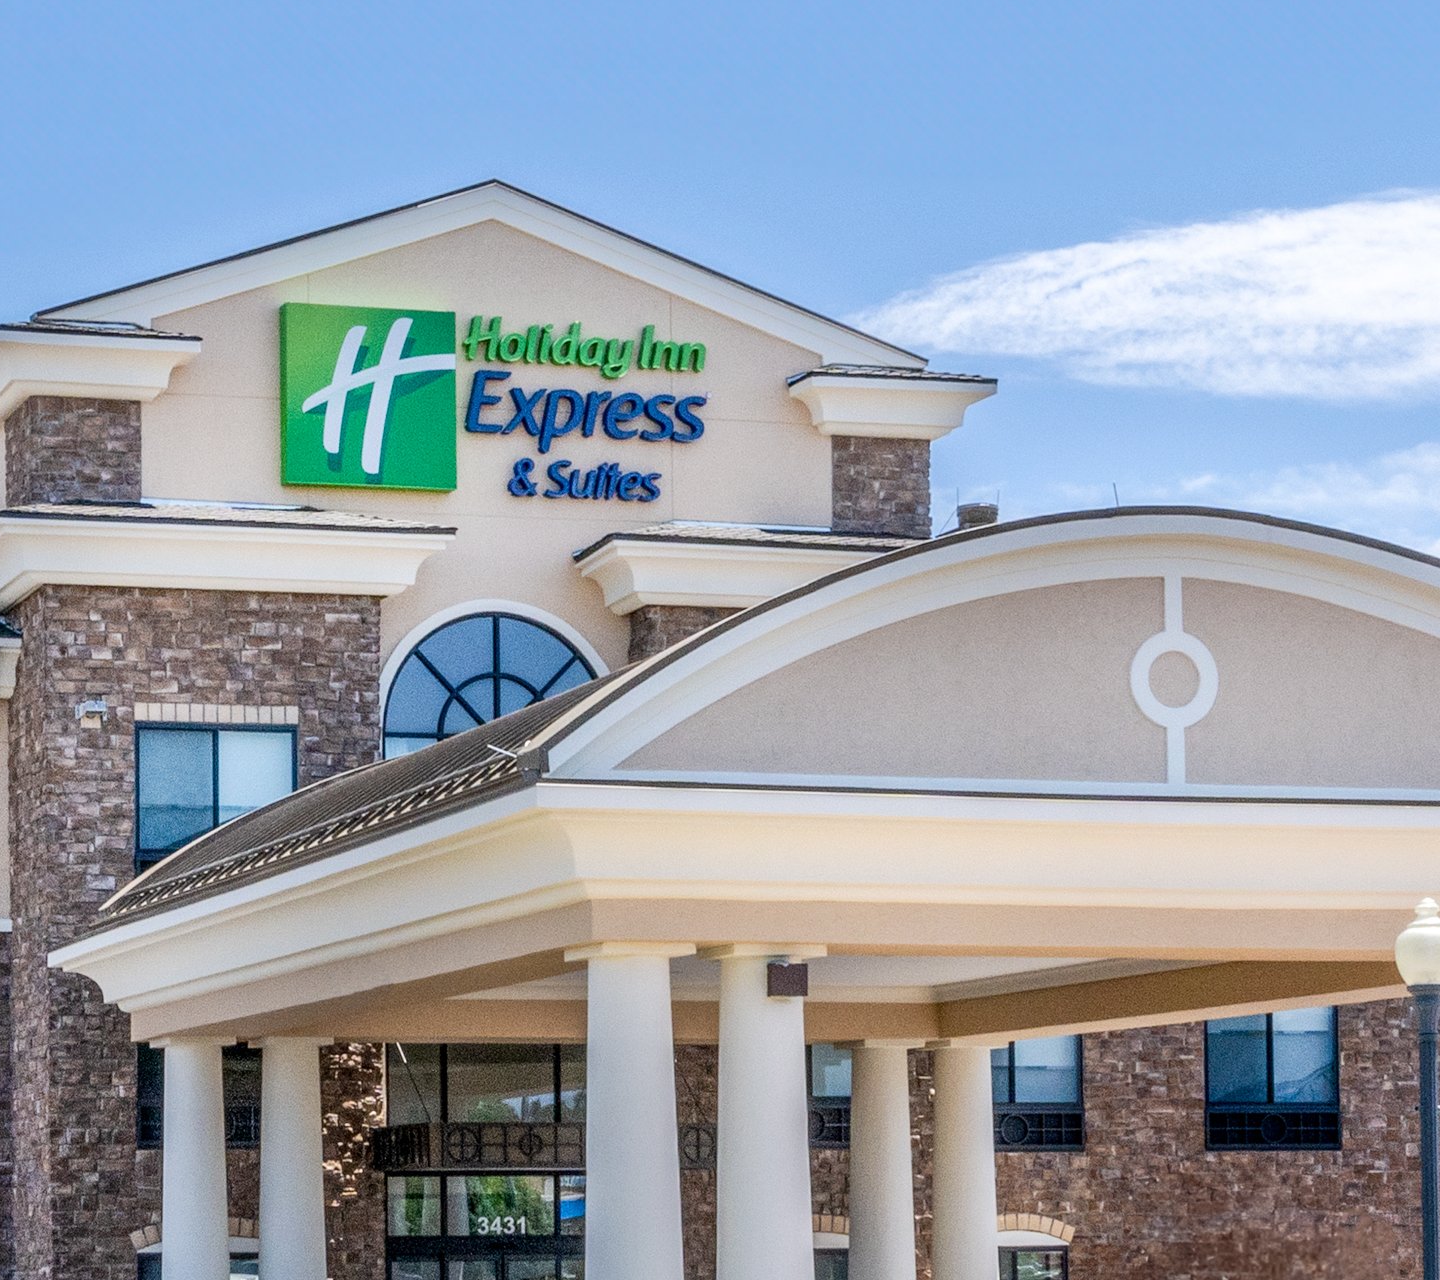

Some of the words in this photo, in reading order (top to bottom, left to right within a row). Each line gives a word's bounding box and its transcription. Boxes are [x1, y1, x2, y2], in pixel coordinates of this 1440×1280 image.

[463, 315, 634, 379] Holiday
[638, 324, 707, 373] Inn
[464, 369, 708, 454] Express
[507, 457, 537, 497] &
[543, 459, 663, 502] Suites
[477, 1216, 526, 1235] 3431
